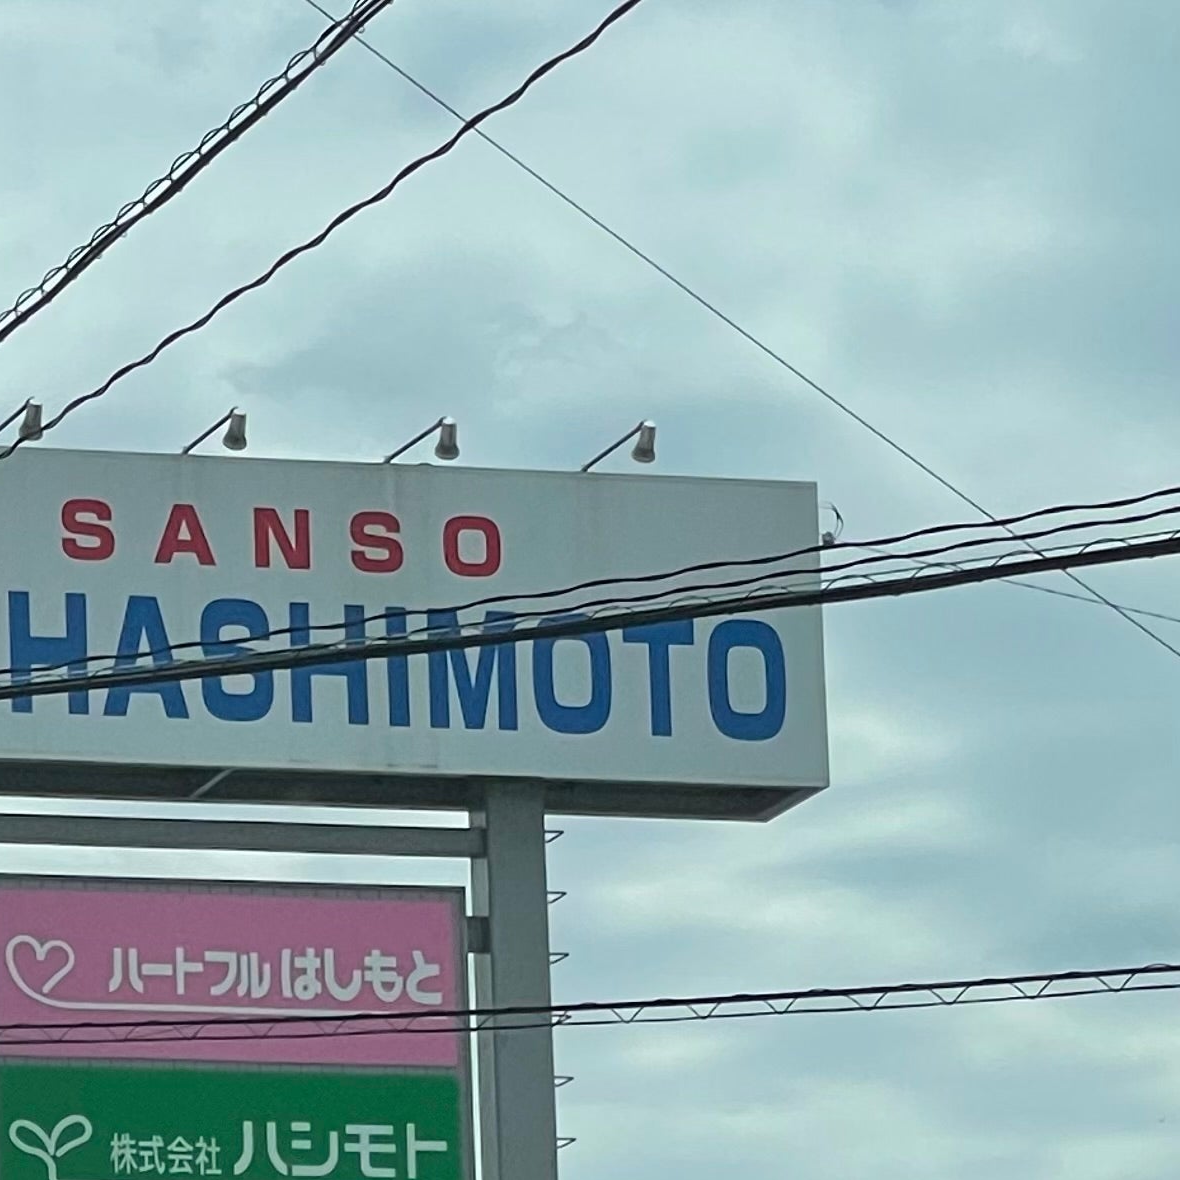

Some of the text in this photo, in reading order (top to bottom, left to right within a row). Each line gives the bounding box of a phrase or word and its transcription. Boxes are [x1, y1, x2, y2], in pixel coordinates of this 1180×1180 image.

[61, 499, 501, 577] SANSO
[8, 590, 786, 741] HASHIMOTO
[108, 945, 444, 1005] ハートフルはしもと
